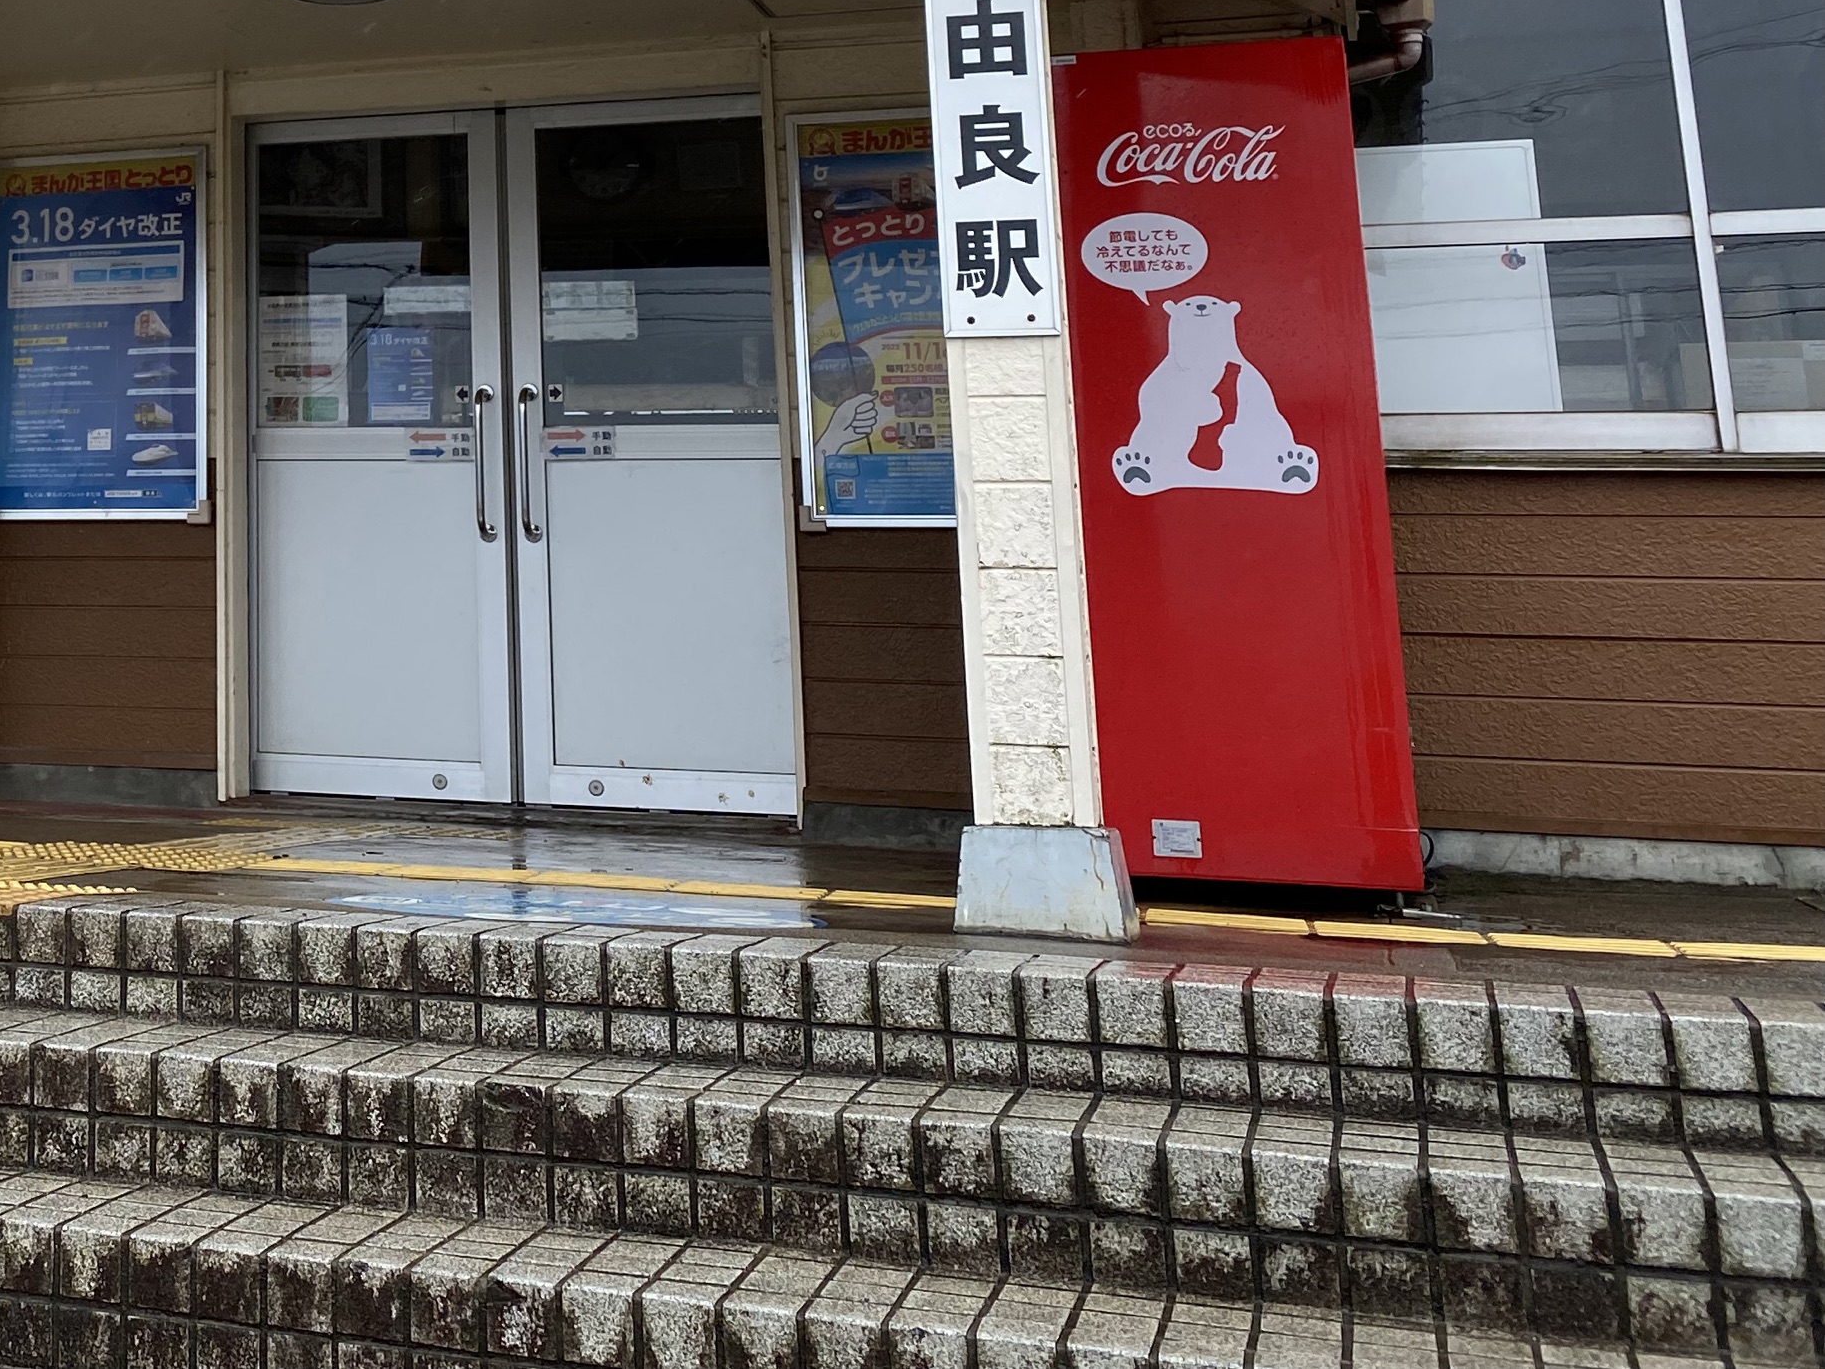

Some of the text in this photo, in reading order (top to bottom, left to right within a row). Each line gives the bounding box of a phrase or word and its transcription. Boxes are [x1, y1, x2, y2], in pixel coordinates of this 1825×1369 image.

[1097, 125, 1286, 187] Coca-Cola
[1109, 229, 1179, 243] 節電しても
[1096, 244, 1191, 258] 冷えてるなんて
[1104, 260, 1193, 273] 不思議だなぁ。
[854, 280, 942, 308] キャン
[902, 341, 947, 362] 11/1
[451, 434, 470, 443] 手動
[591, 431, 612, 441] 手動
[452, 447, 470, 457] 自動
[592, 445, 612, 456] 自動
